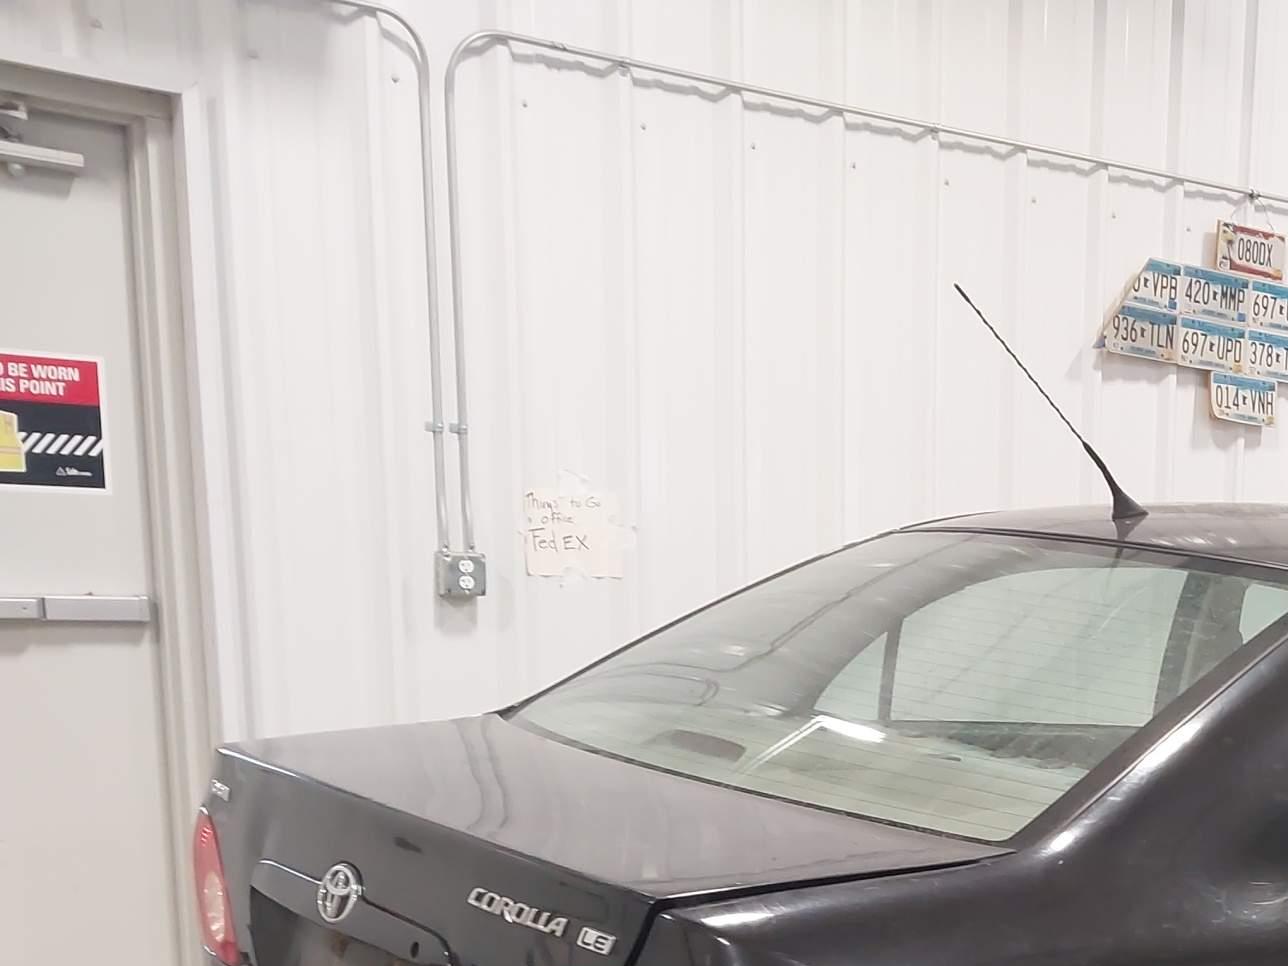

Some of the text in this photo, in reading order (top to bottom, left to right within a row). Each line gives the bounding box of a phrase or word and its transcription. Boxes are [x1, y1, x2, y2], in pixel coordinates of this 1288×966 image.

[1185, 279, 1210, 305] 420
[1253, 295, 1277, 319] 697
[1113, 315, 1137, 342] 936
[1182, 331, 1207, 357] 697
[1249, 342, 1274, 368] 378
[8, 362, 28, 378] BE
[31, 364, 80, 382] WORN
[0, 377, 66, 396] IS POINT
[1216, 385, 1239, 411] 014
[467, 887, 614, 954] COROLLA LE
